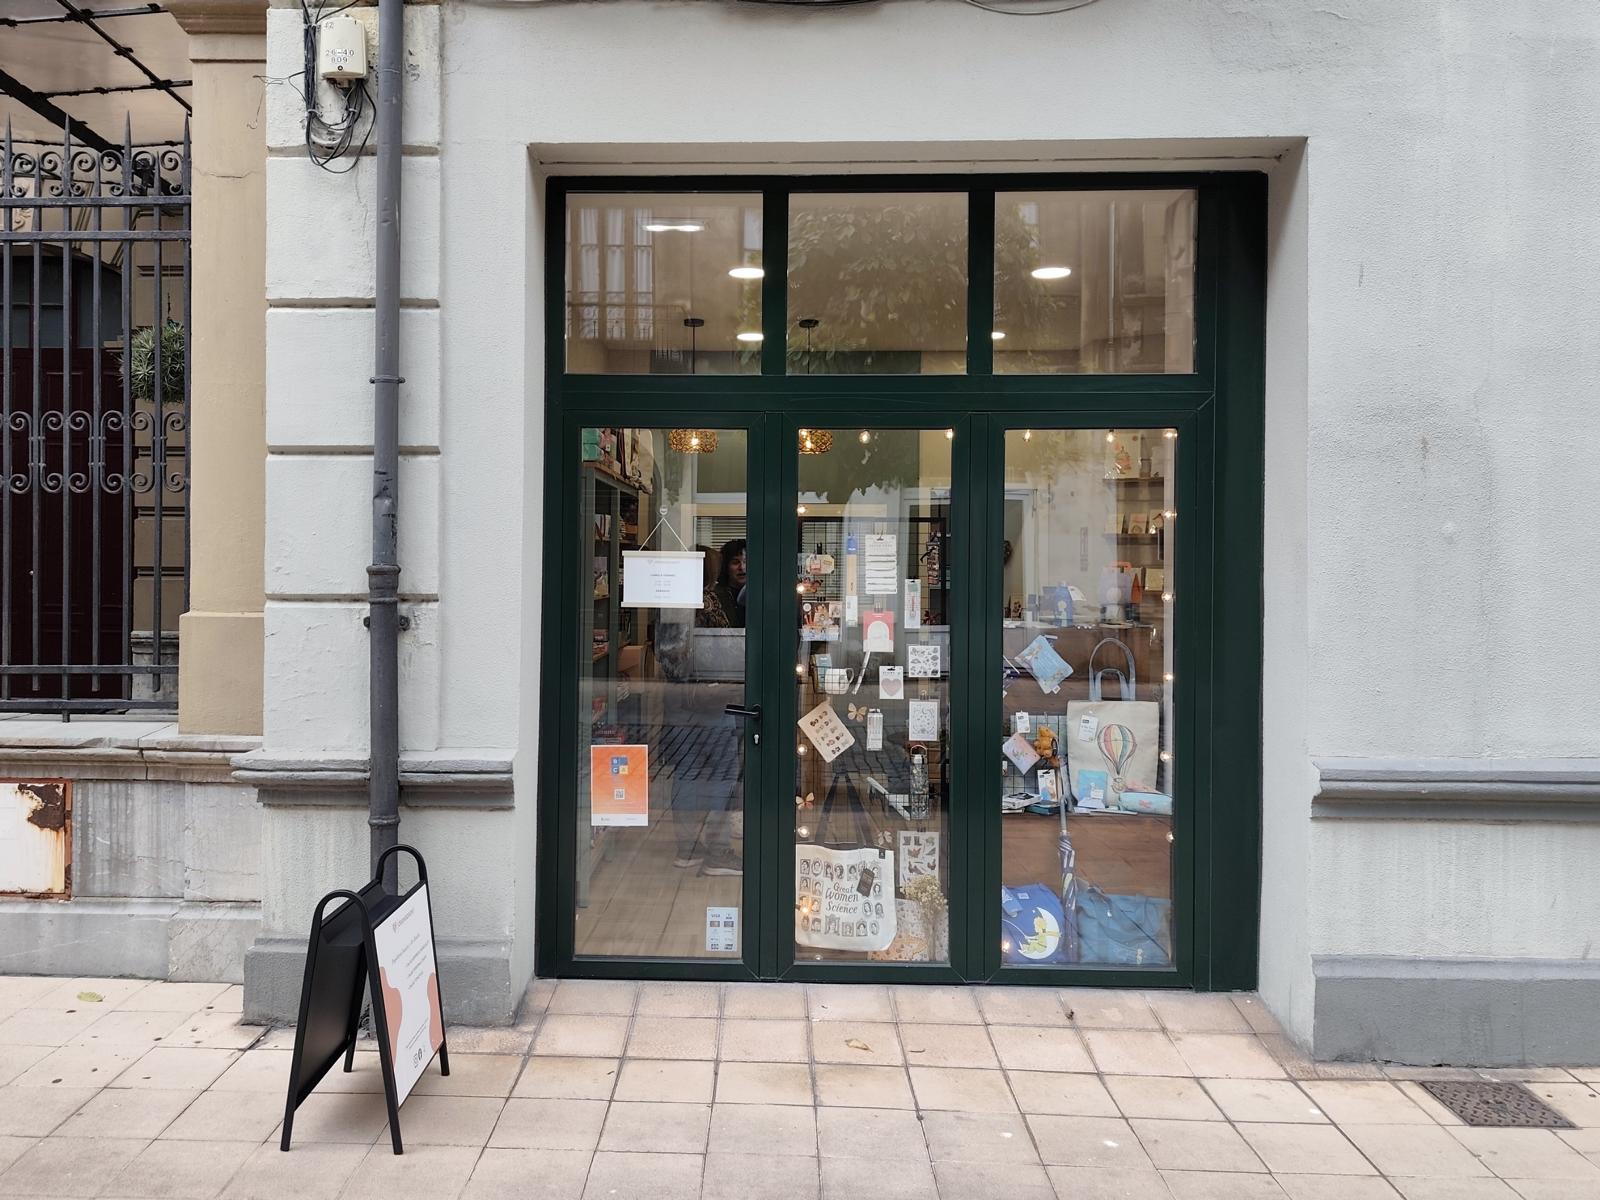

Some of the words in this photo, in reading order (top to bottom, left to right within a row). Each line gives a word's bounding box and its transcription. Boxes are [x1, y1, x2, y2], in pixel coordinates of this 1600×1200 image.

[833, 881, 855, 894] Great
[825, 887, 859, 903] Women
[825, 901, 858, 914] Science
